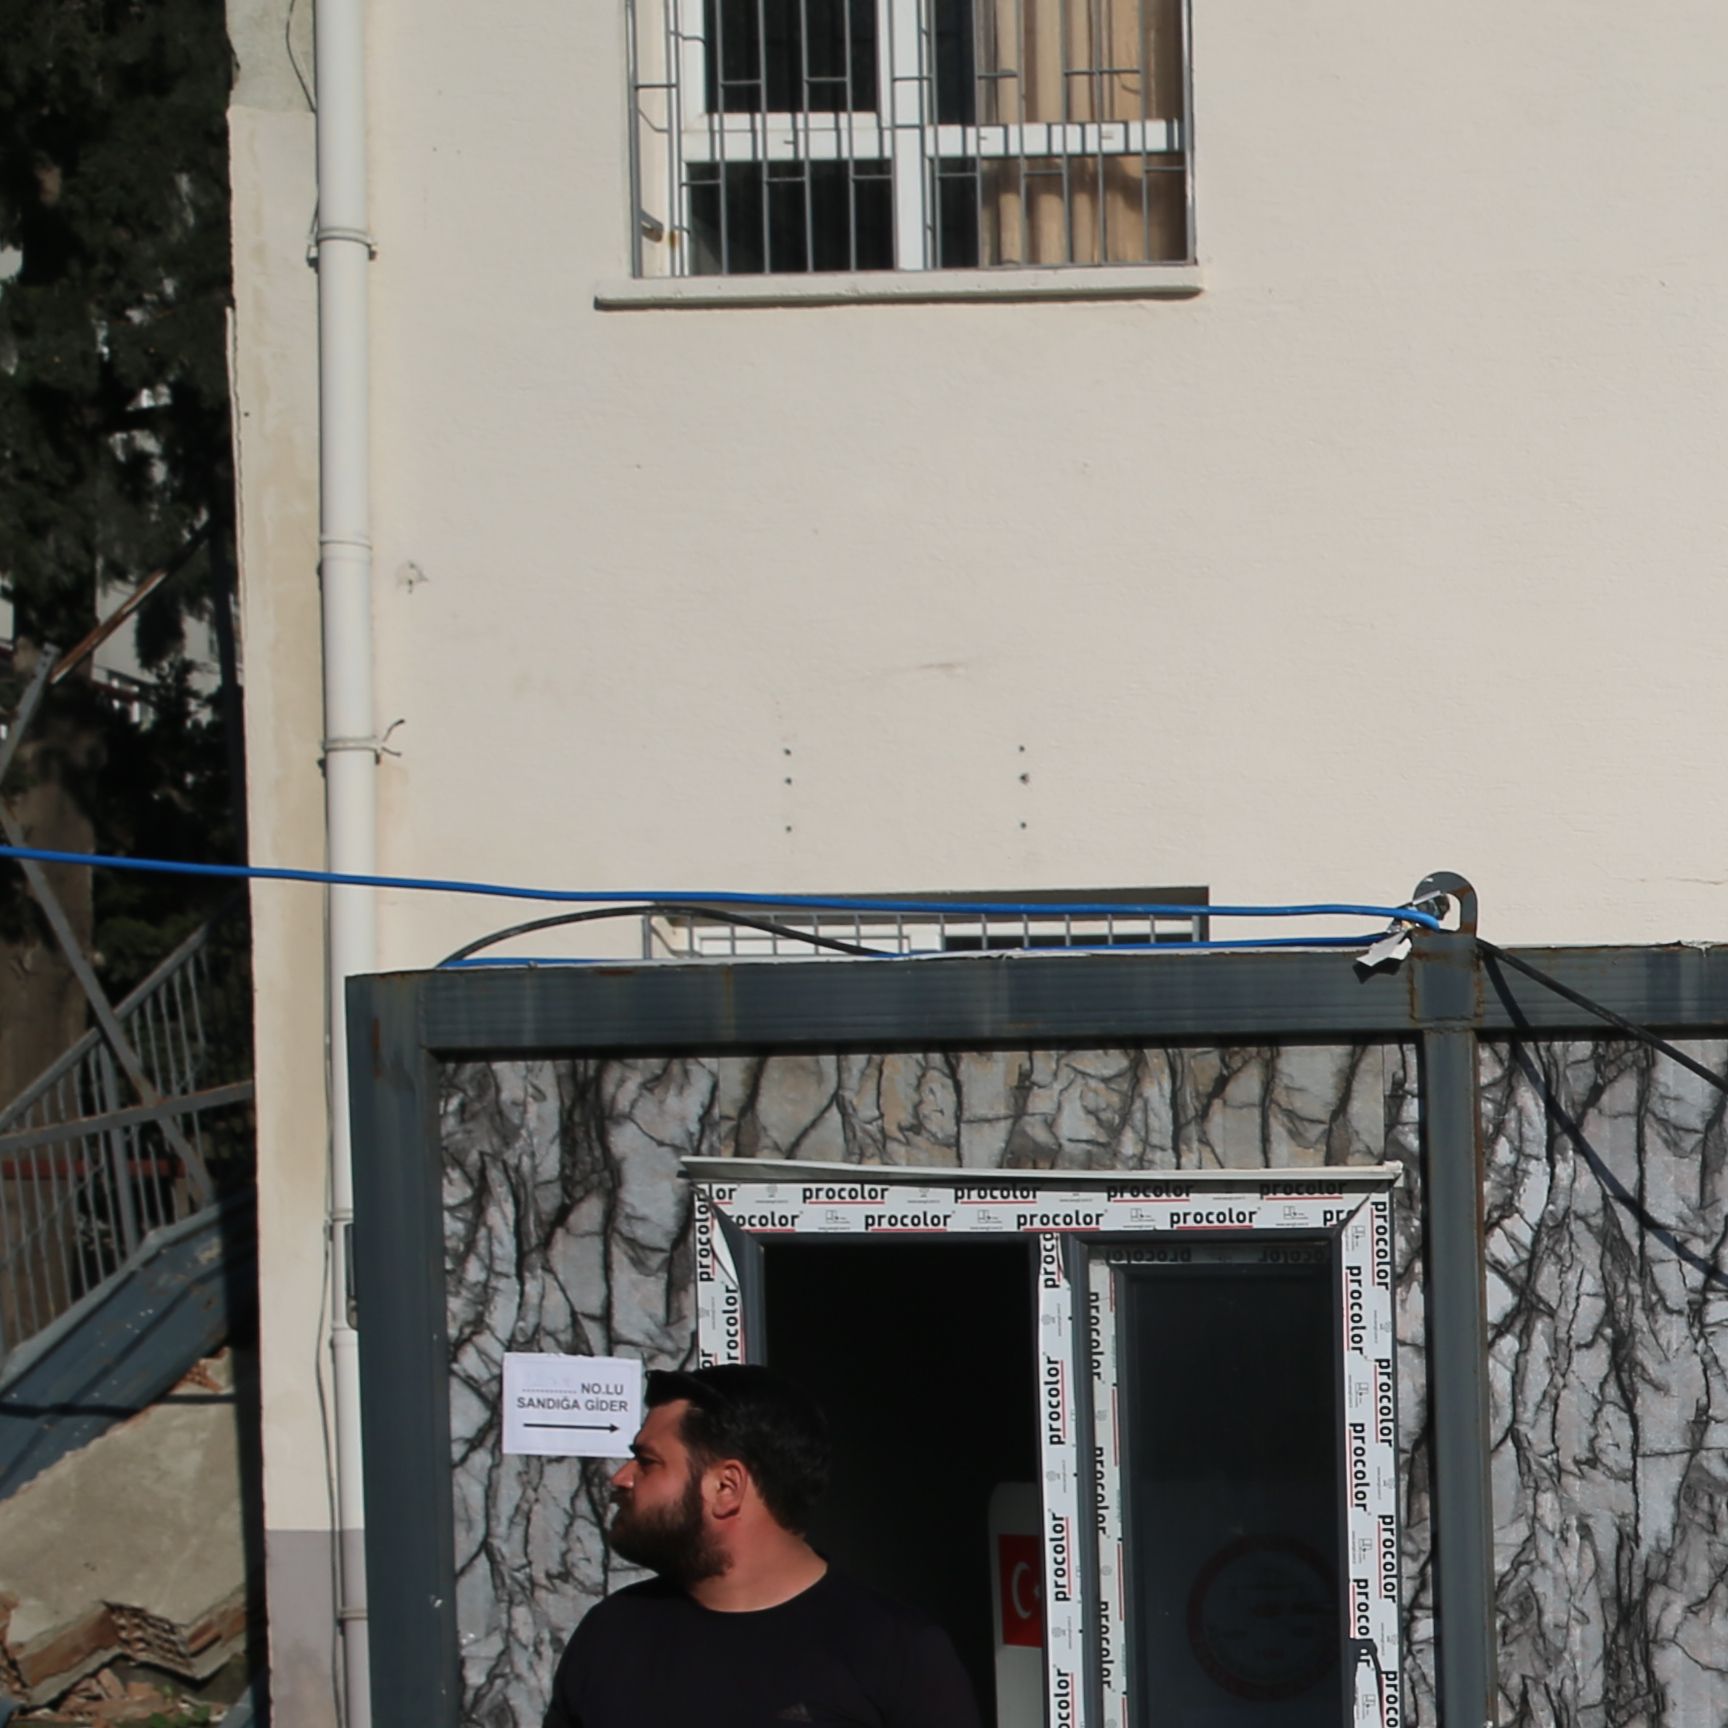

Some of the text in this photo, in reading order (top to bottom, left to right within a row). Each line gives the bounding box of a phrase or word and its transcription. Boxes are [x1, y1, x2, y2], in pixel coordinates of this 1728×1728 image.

[802, 1180, 1347, 1203] procolor procolor procolor procolor
[865, 1211, 951, 1230] procolor
[1017, 1210, 1104, 1230] procolor
[1170, 1208, 1257, 1229] procolor
[1371, 1201, 1389, 1291] procolor
[722, 1285, 738, 1364] rocolor
[1347, 1265, 1364, 1356] procolor
[516, 1396, 628, 1412] SANDIĞA GİDER
[1044, 1355, 1065, 1445] procolor
[1375, 1358, 1392, 1448] procolor
[1350, 1422, 1367, 1512] procolor
[1049, 1512, 1070, 1602] procolor
[1378, 1514, 1396, 1603] procolor
